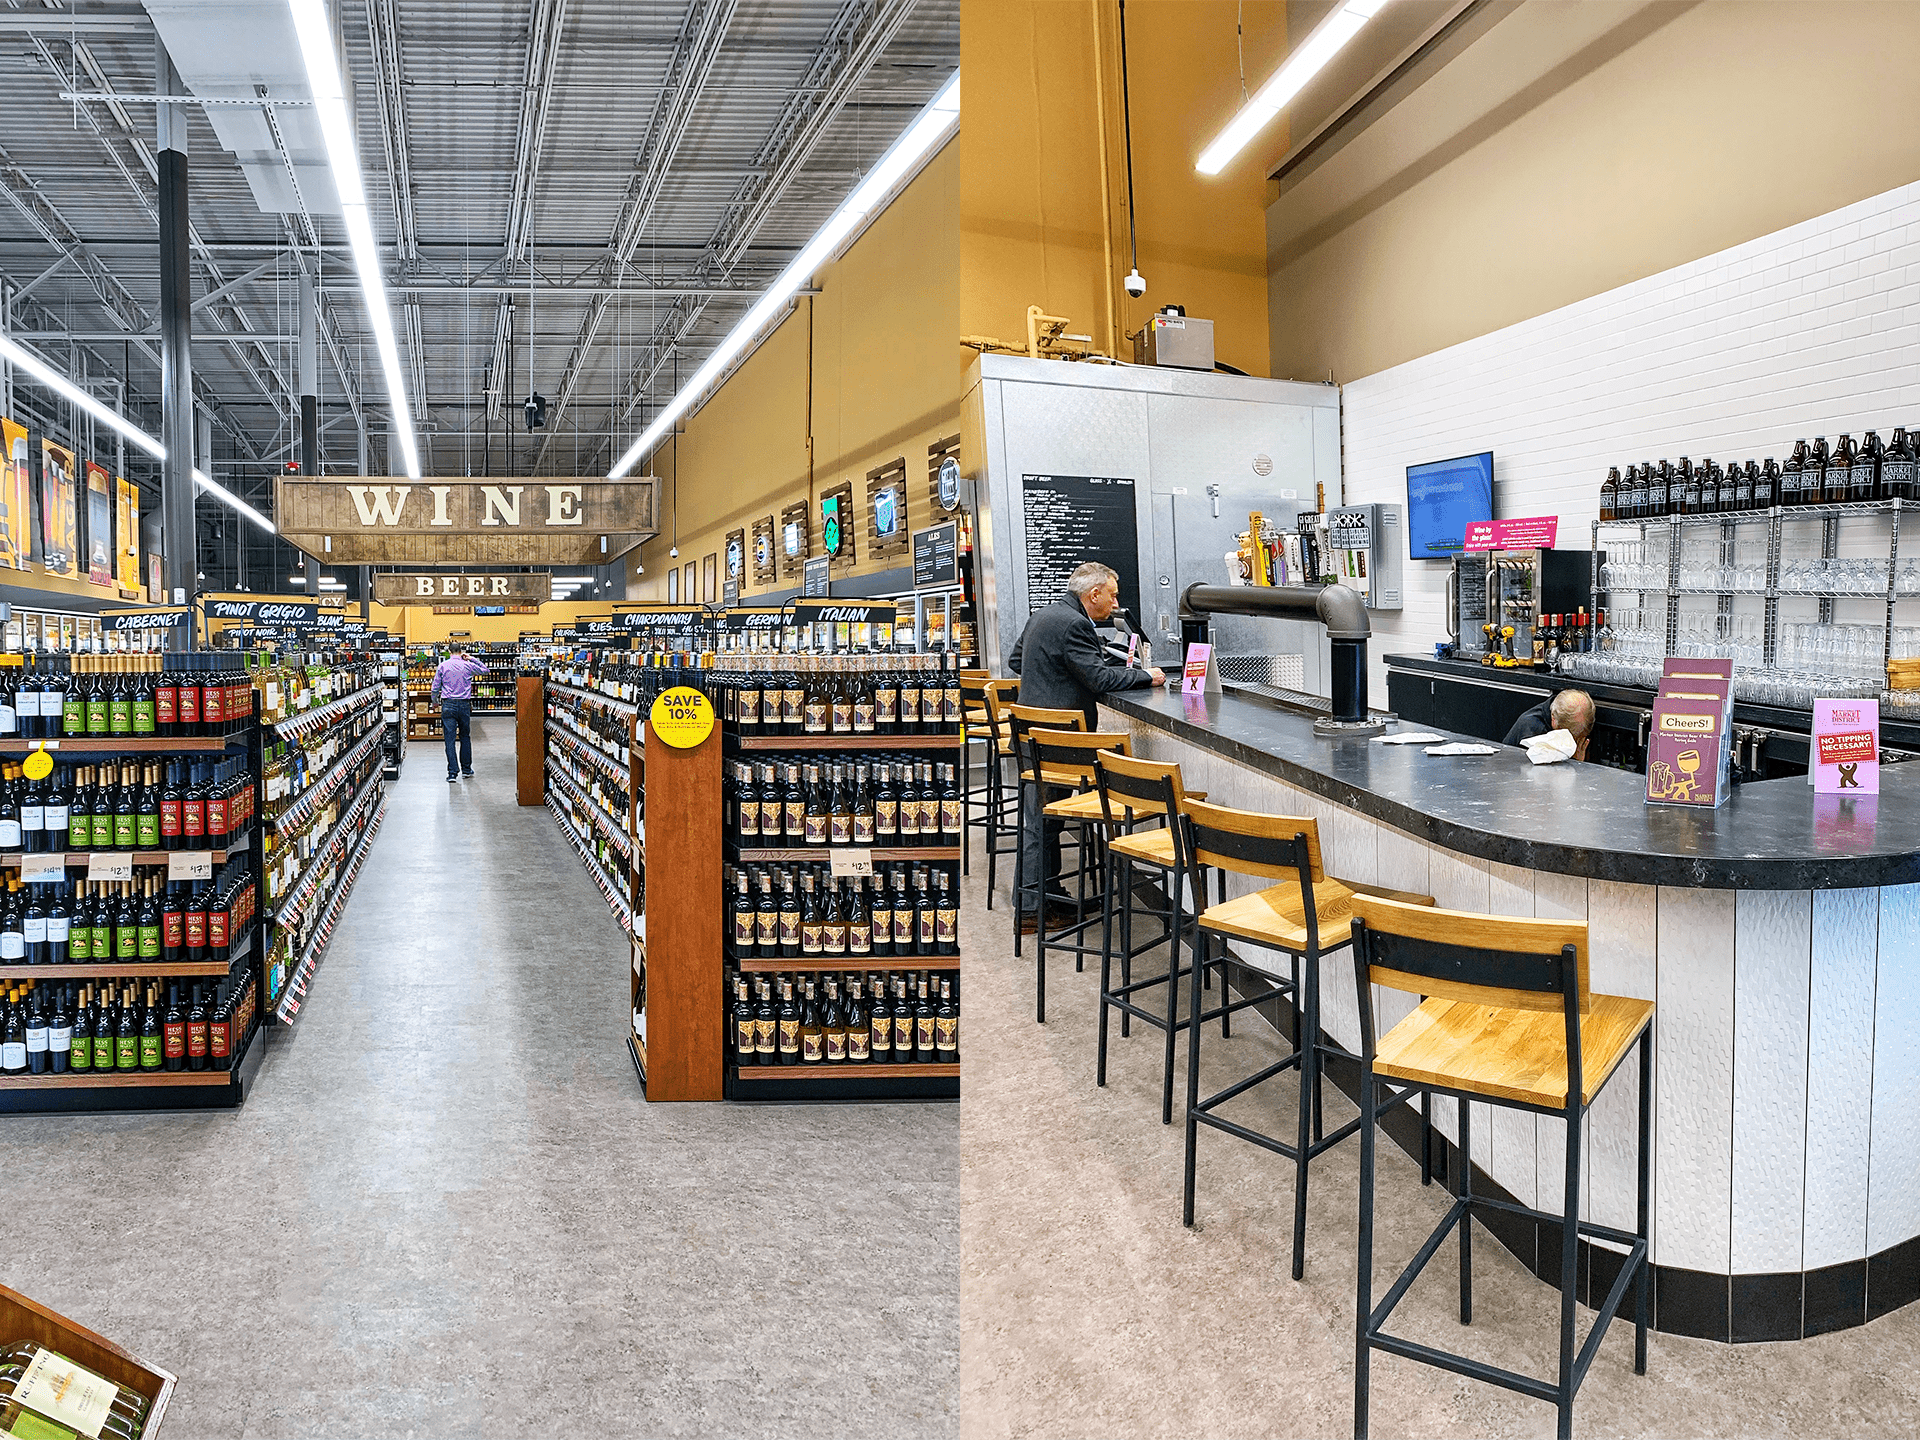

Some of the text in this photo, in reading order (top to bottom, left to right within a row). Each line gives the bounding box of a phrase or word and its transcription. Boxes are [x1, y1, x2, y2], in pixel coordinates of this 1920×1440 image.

[1883, 465, 1911, 474] MARKET
[346, 485, 584, 526] WINE
[65, 460, 77, 567] LAGER
[927, 531, 941, 542] ALES
[415, 576, 511, 596] BEER
[214, 602, 306, 618] PINOT GRIGIO
[818, 607, 870, 622] ITALIAN
[115, 613, 183, 629] CABERNET
[317, 616, 344, 627] BLANC
[624, 613, 693, 626] CHARDONNAY
[256, 628, 278, 637] NOIR
[663, 695, 702, 707] SAVE
[669, 708, 697, 720] 10%
[1832, 710, 1861, 718] MARKET
[1666, 717, 1709, 728] CheerS!
[1836, 734, 1871, 743] TIPPING
[1822, 741, 1872, 751] NECESSARY!
[20, 1353, 50, 1400] RUFFINO
